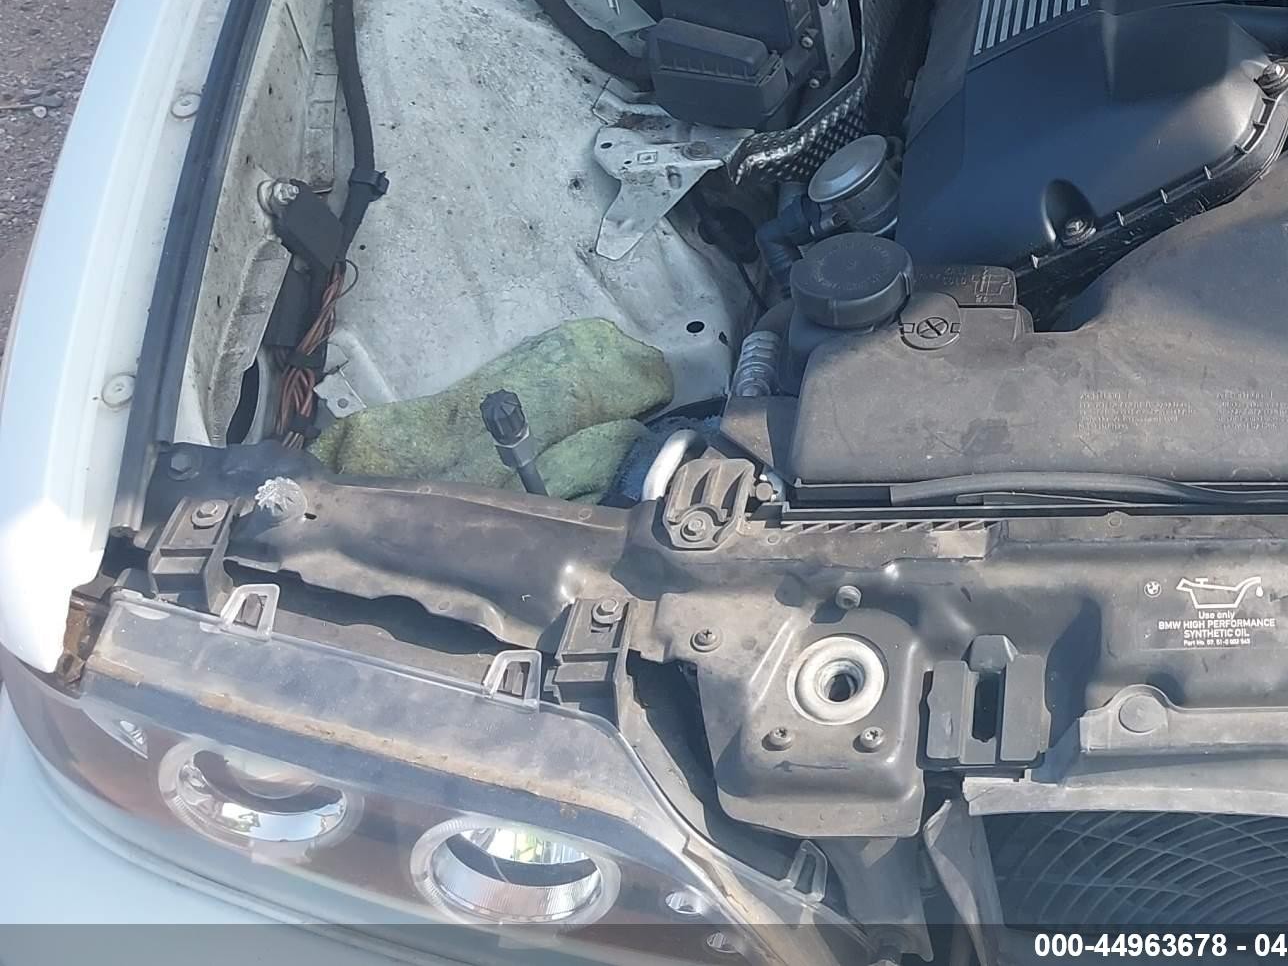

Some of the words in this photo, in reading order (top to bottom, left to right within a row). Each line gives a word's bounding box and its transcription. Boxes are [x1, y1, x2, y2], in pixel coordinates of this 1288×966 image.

[1198, 610, 1215, 620] Use
[1217, 610, 1235, 620] only
[1158, 620, 1181, 630] BMW
[1183, 620, 1205, 629] HIGH
[1208, 618, 1276, 628] PERFORMANCE
[1184, 628, 1233, 638] SYNTHETIC
[1234, 628, 1250, 637] OIL
